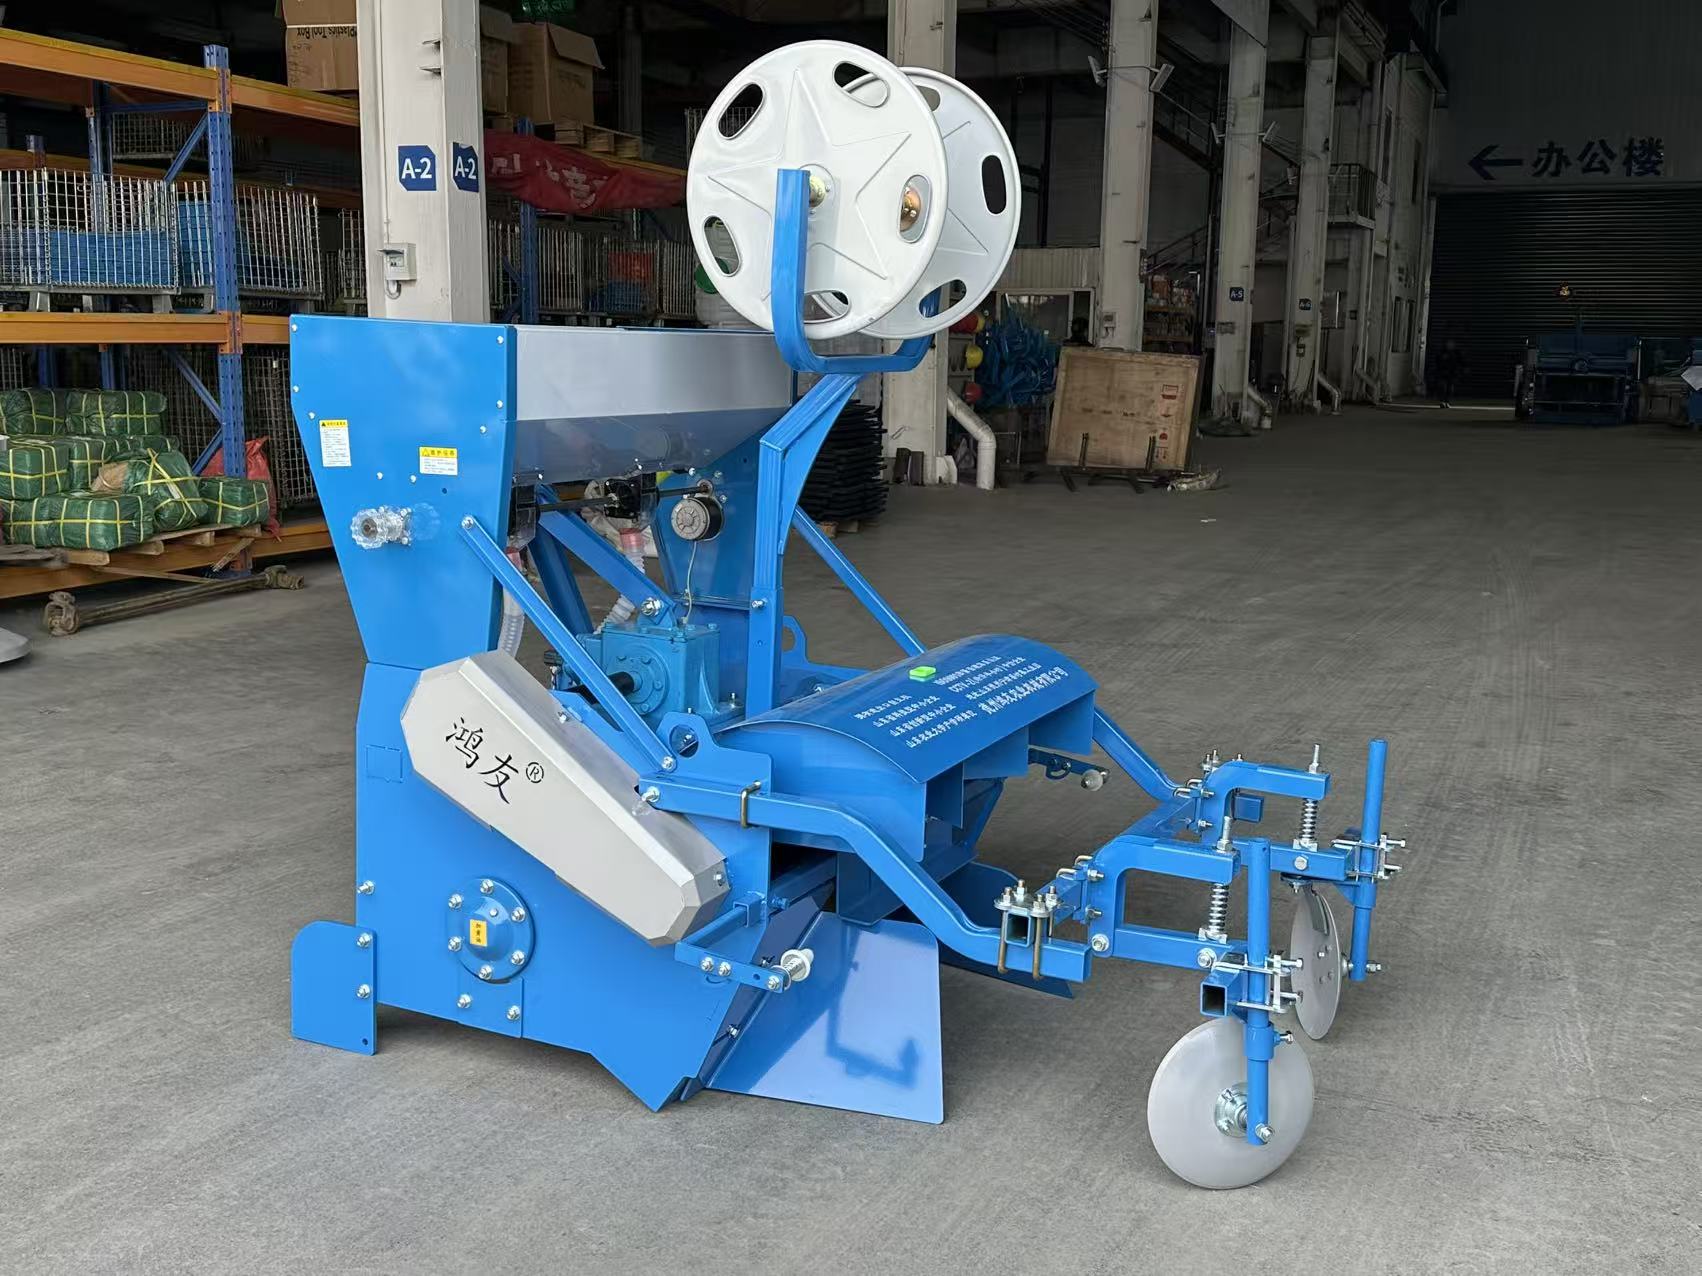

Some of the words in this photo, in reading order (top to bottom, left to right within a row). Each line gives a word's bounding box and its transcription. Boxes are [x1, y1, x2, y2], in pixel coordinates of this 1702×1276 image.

[401, 158, 432, 179] A-2
[454, 156, 477, 180] A-2
[1531, 138, 1664, 177] 办公楼
[445, 717, 519, 804] 鸿友
